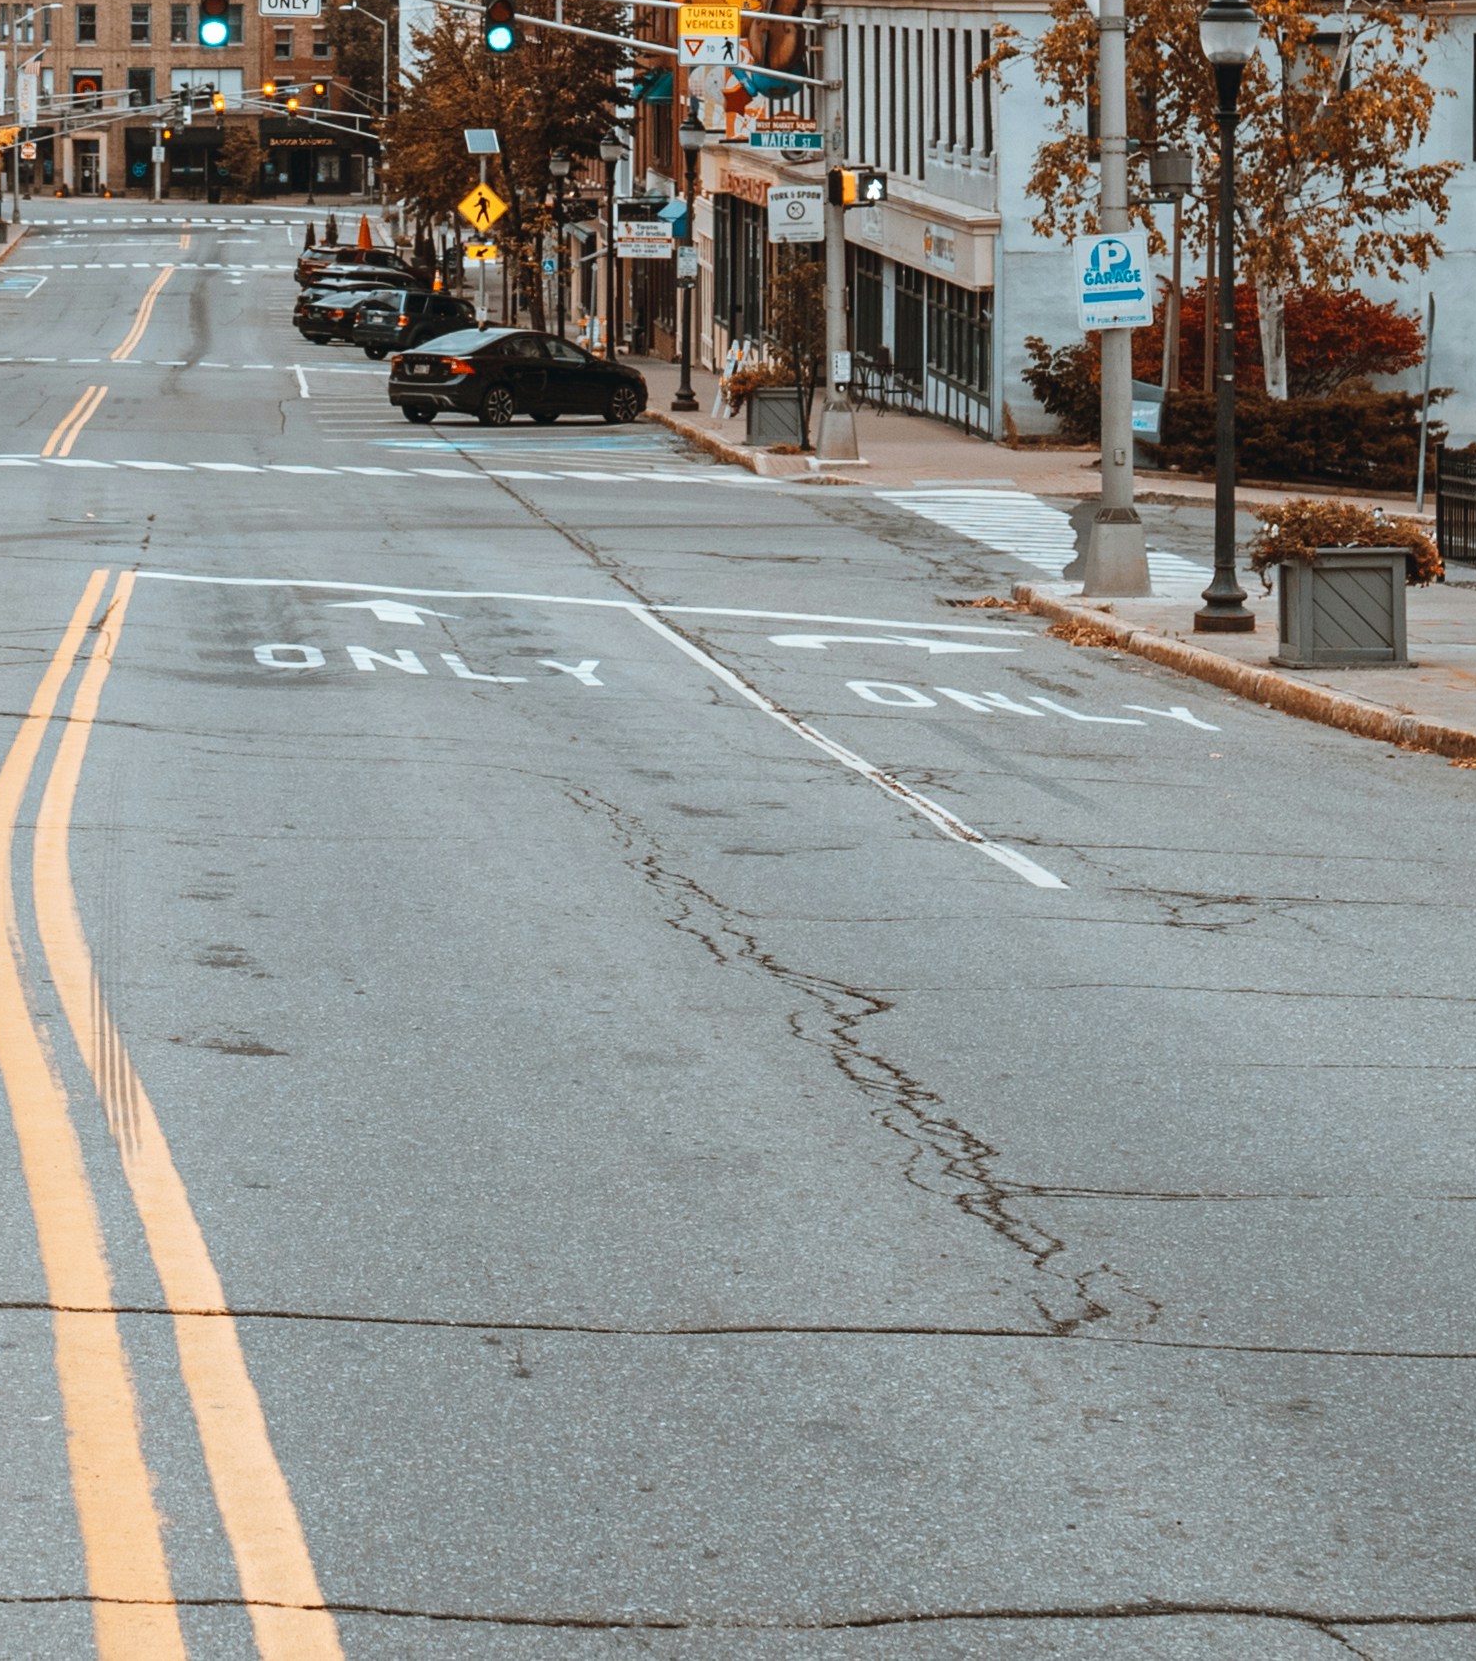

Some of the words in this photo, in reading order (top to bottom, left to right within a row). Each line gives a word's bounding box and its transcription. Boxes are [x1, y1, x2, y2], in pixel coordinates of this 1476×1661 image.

[688, 8, 733, 18] TURNING
[686, 19, 735, 29] VEHICLES
[761, 132, 796, 147] WATER
[802, 138, 811, 147] ST
[797, 190, 822, 200] SPOON
[1098, 243, 1127, 272] P
[1084, 269, 1142, 286] GARAGE
[253, 643, 605, 687] ONLY
[845, 680, 1223, 731] ONLY
